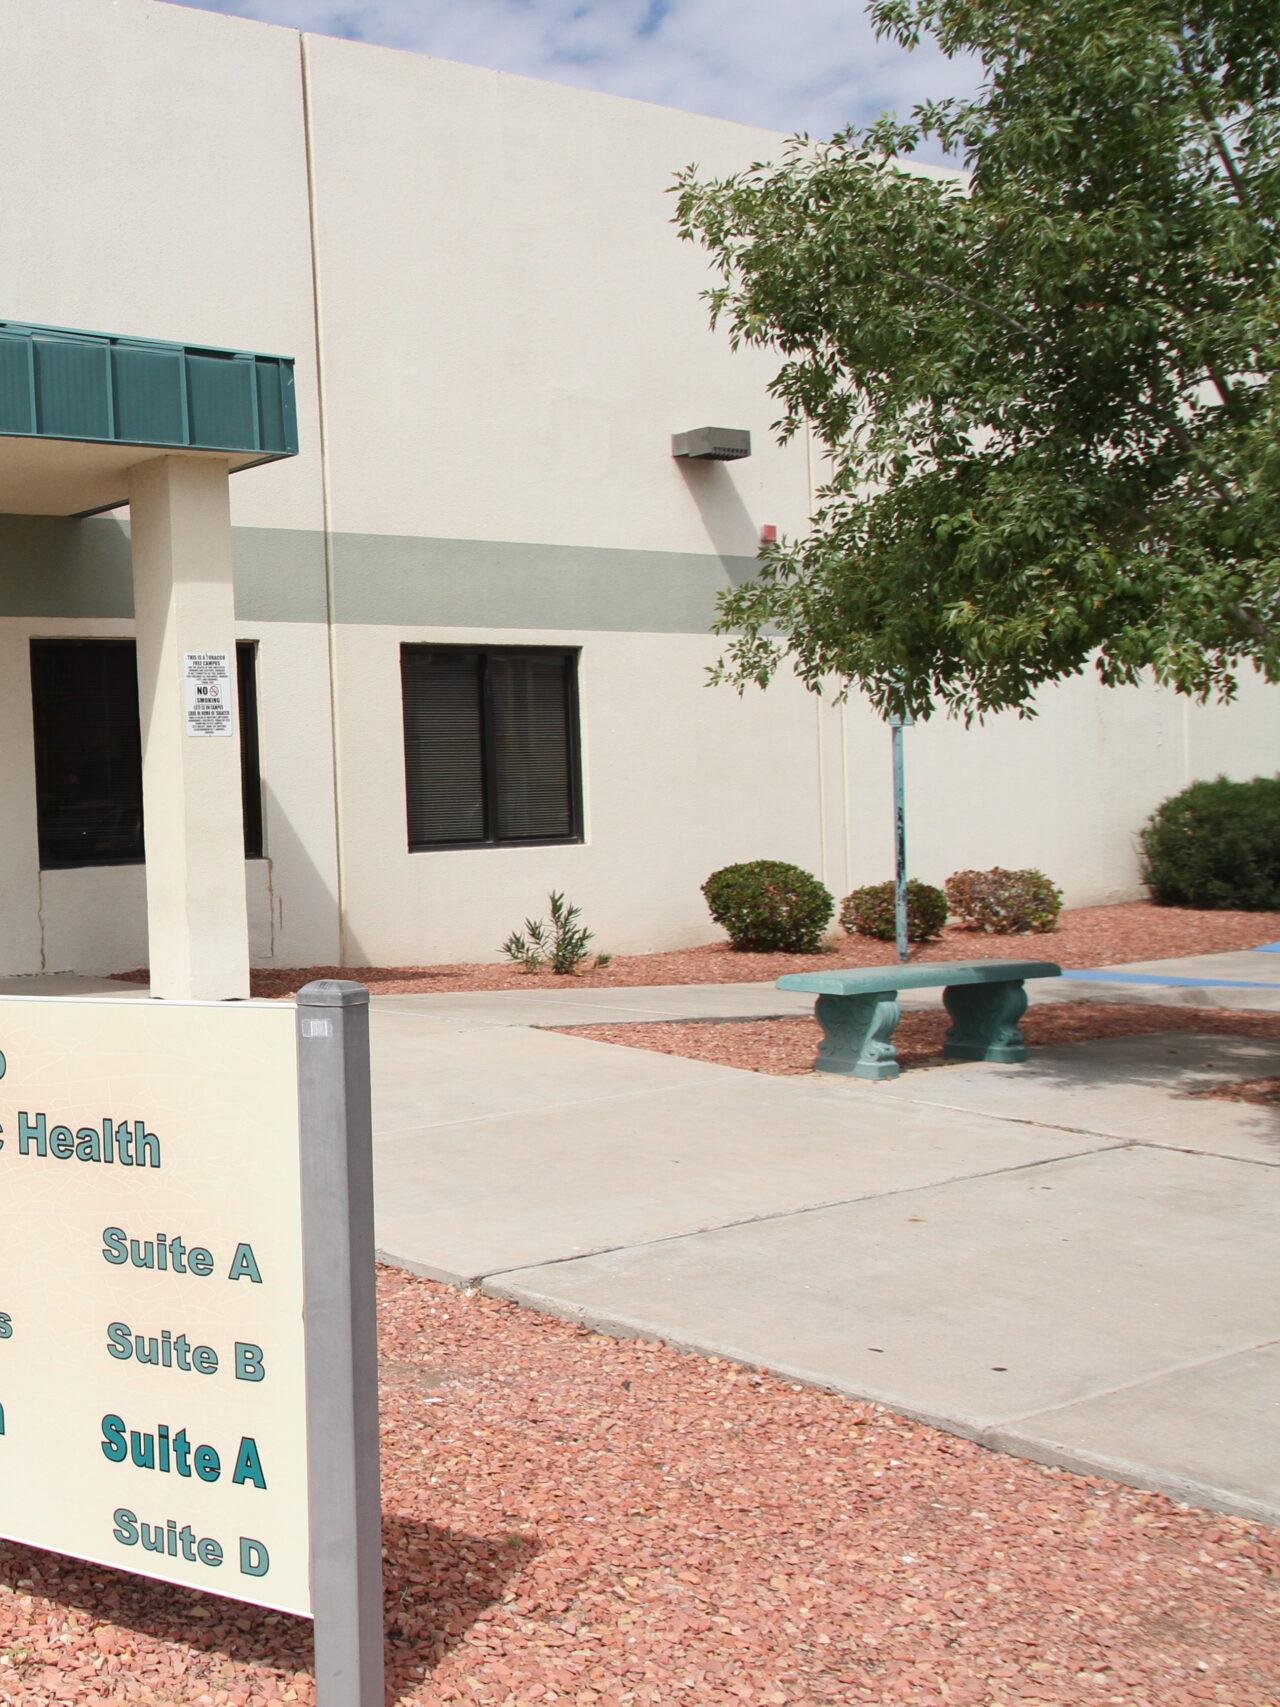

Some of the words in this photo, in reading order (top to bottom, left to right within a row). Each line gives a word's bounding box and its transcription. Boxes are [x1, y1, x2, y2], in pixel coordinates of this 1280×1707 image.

[197, 686, 208, 695] NO
[17, 1111, 161, 1169] Health
[102, 1226, 215, 1277] Suite
[227, 1242, 264, 1284] A
[106, 1321, 219, 1376] Suite
[234, 1341, 266, 1383] B
[100, 1413, 222, 1483] Suite
[231, 1435, 268, 1491] A
[112, 1507, 224, 1568] Suite
[239, 1536, 270, 1578] D
